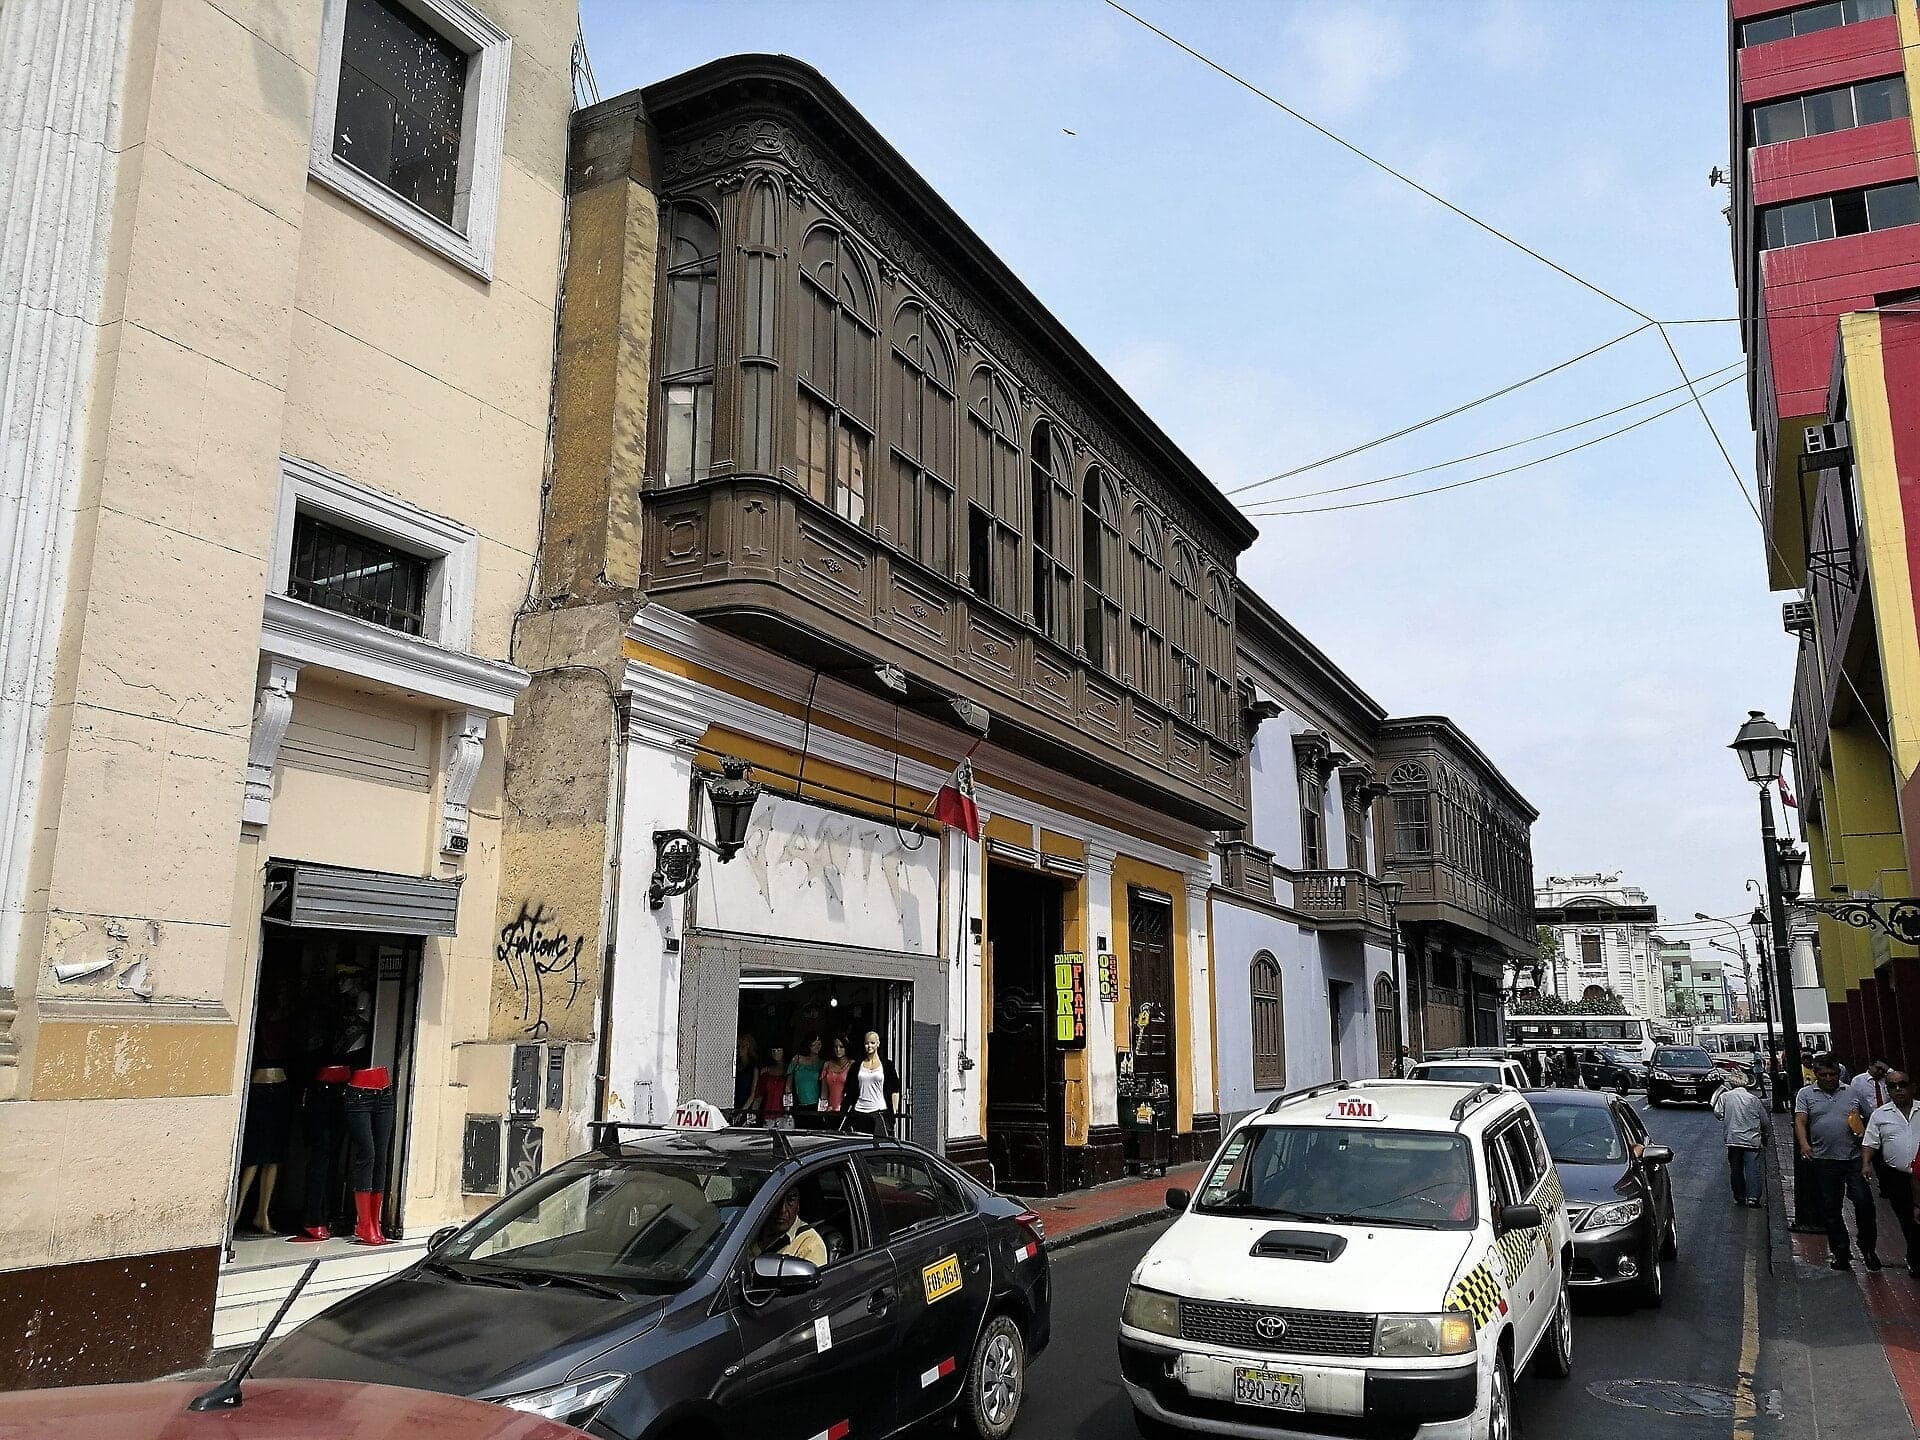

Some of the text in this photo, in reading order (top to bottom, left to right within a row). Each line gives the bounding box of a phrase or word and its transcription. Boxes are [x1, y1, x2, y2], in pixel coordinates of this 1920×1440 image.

[1054, 953, 1083, 964] COMPRO
[1099, 955, 1111, 994] ORO
[1055, 964, 1074, 1040] ORO
[1073, 965, 1084, 1036] PLATA
[676, 1110, 709, 1127] TAXI
[1338, 1102, 1372, 1116] TAXI
